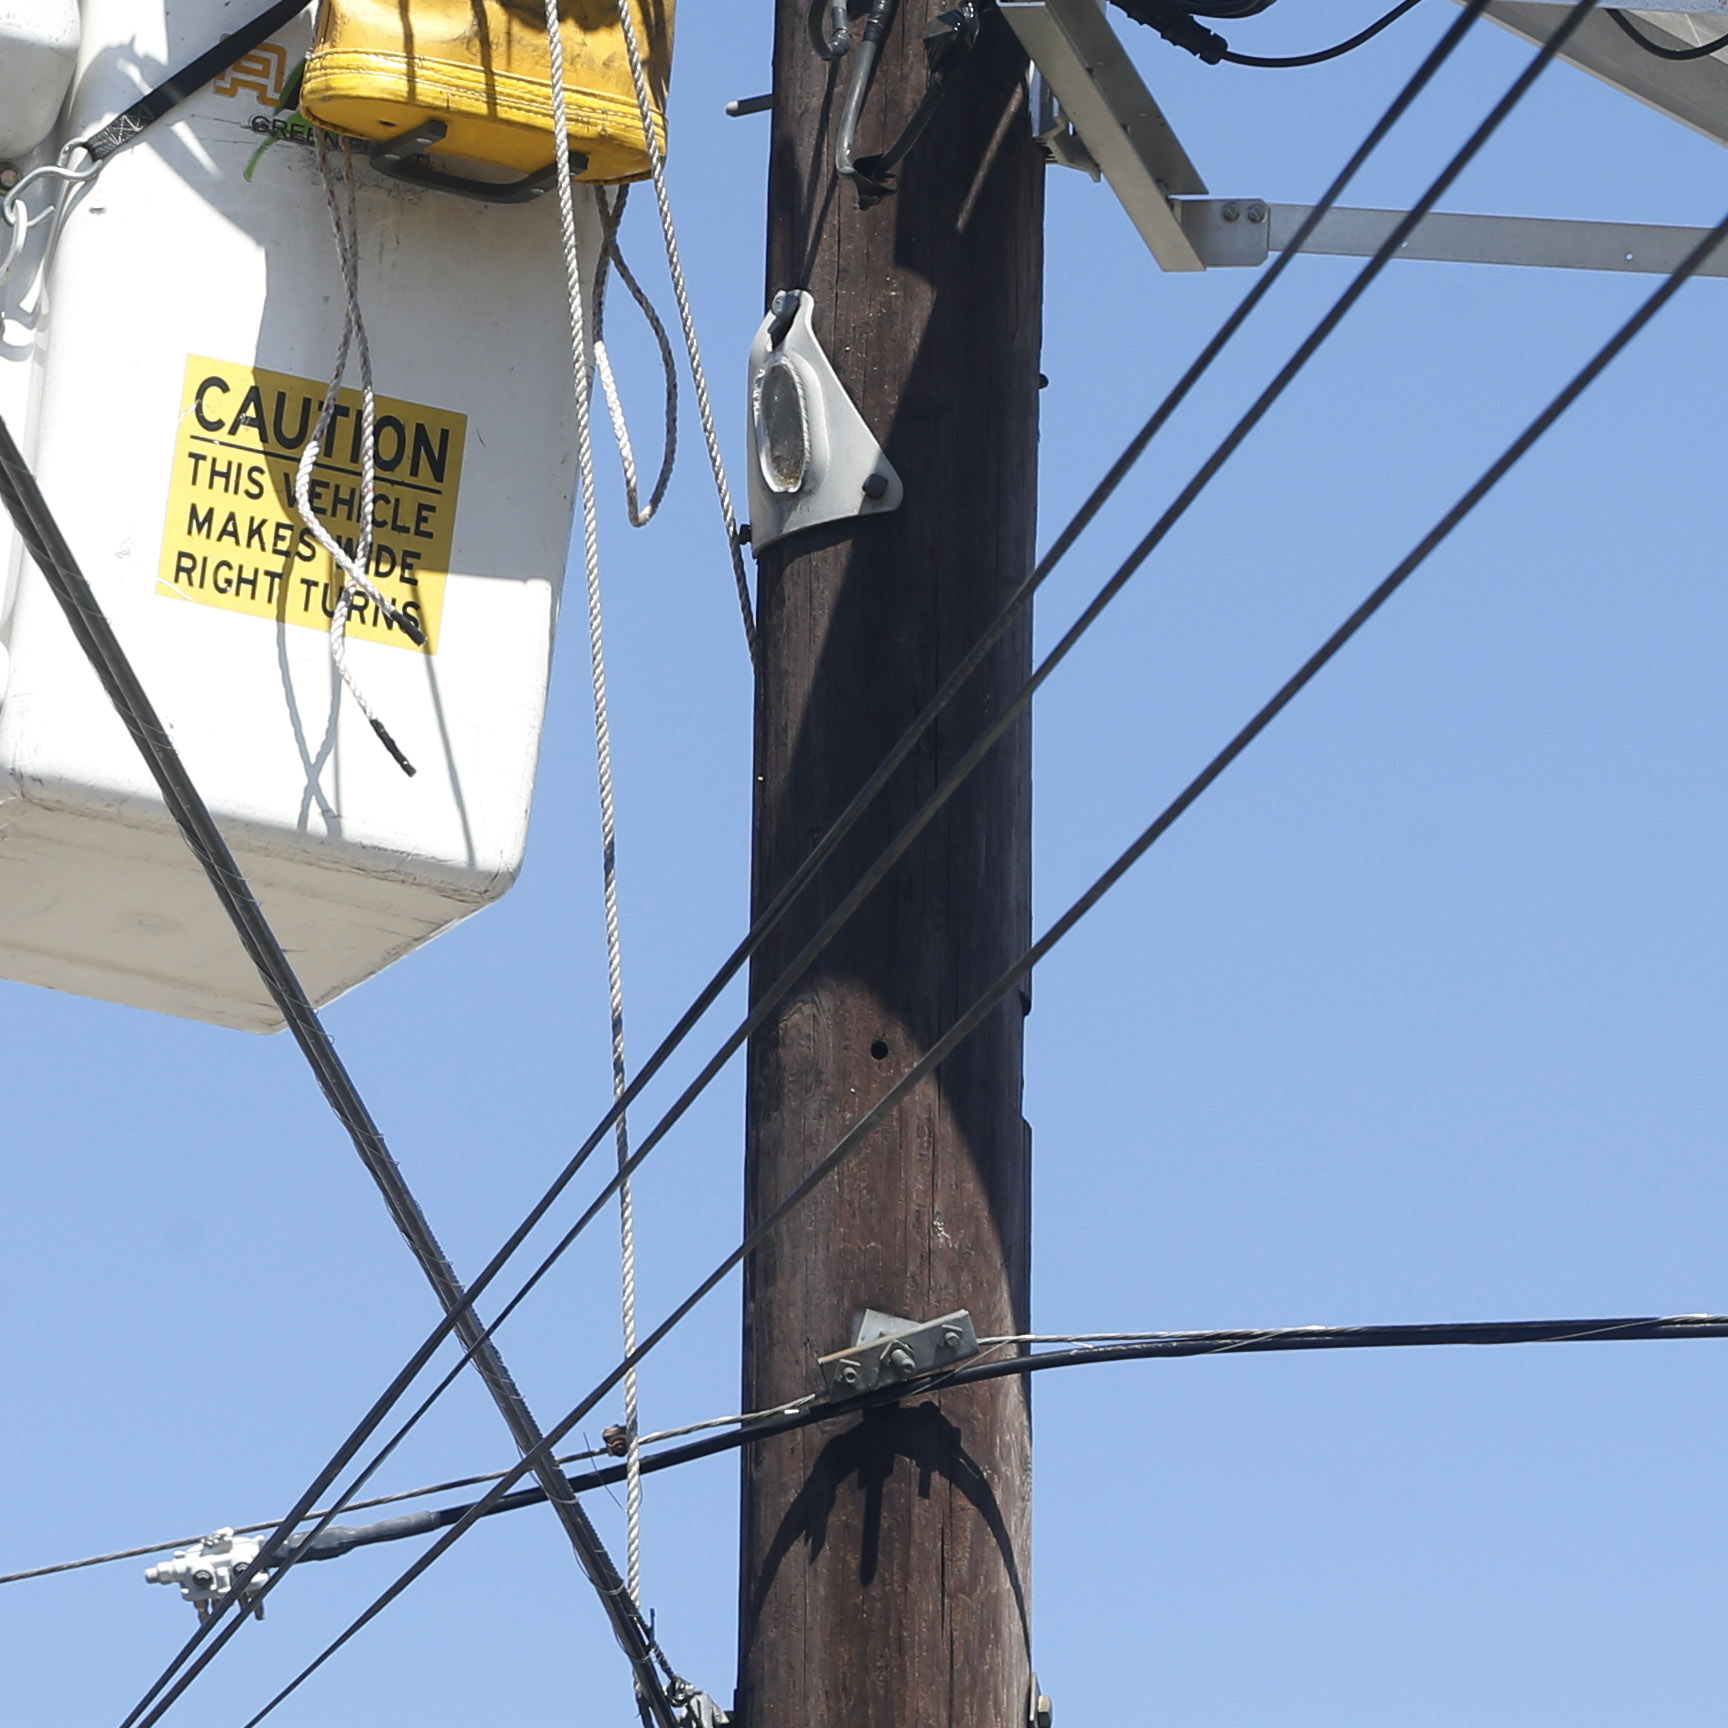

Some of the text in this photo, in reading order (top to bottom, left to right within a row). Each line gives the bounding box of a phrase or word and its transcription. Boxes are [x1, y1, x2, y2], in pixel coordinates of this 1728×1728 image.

[194, 376, 449, 483] CAUTION
[188, 452, 265, 500] THIS
[187, 503, 317, 562] MAKES
[174, 551, 421, 632] RIGHT TURNS
